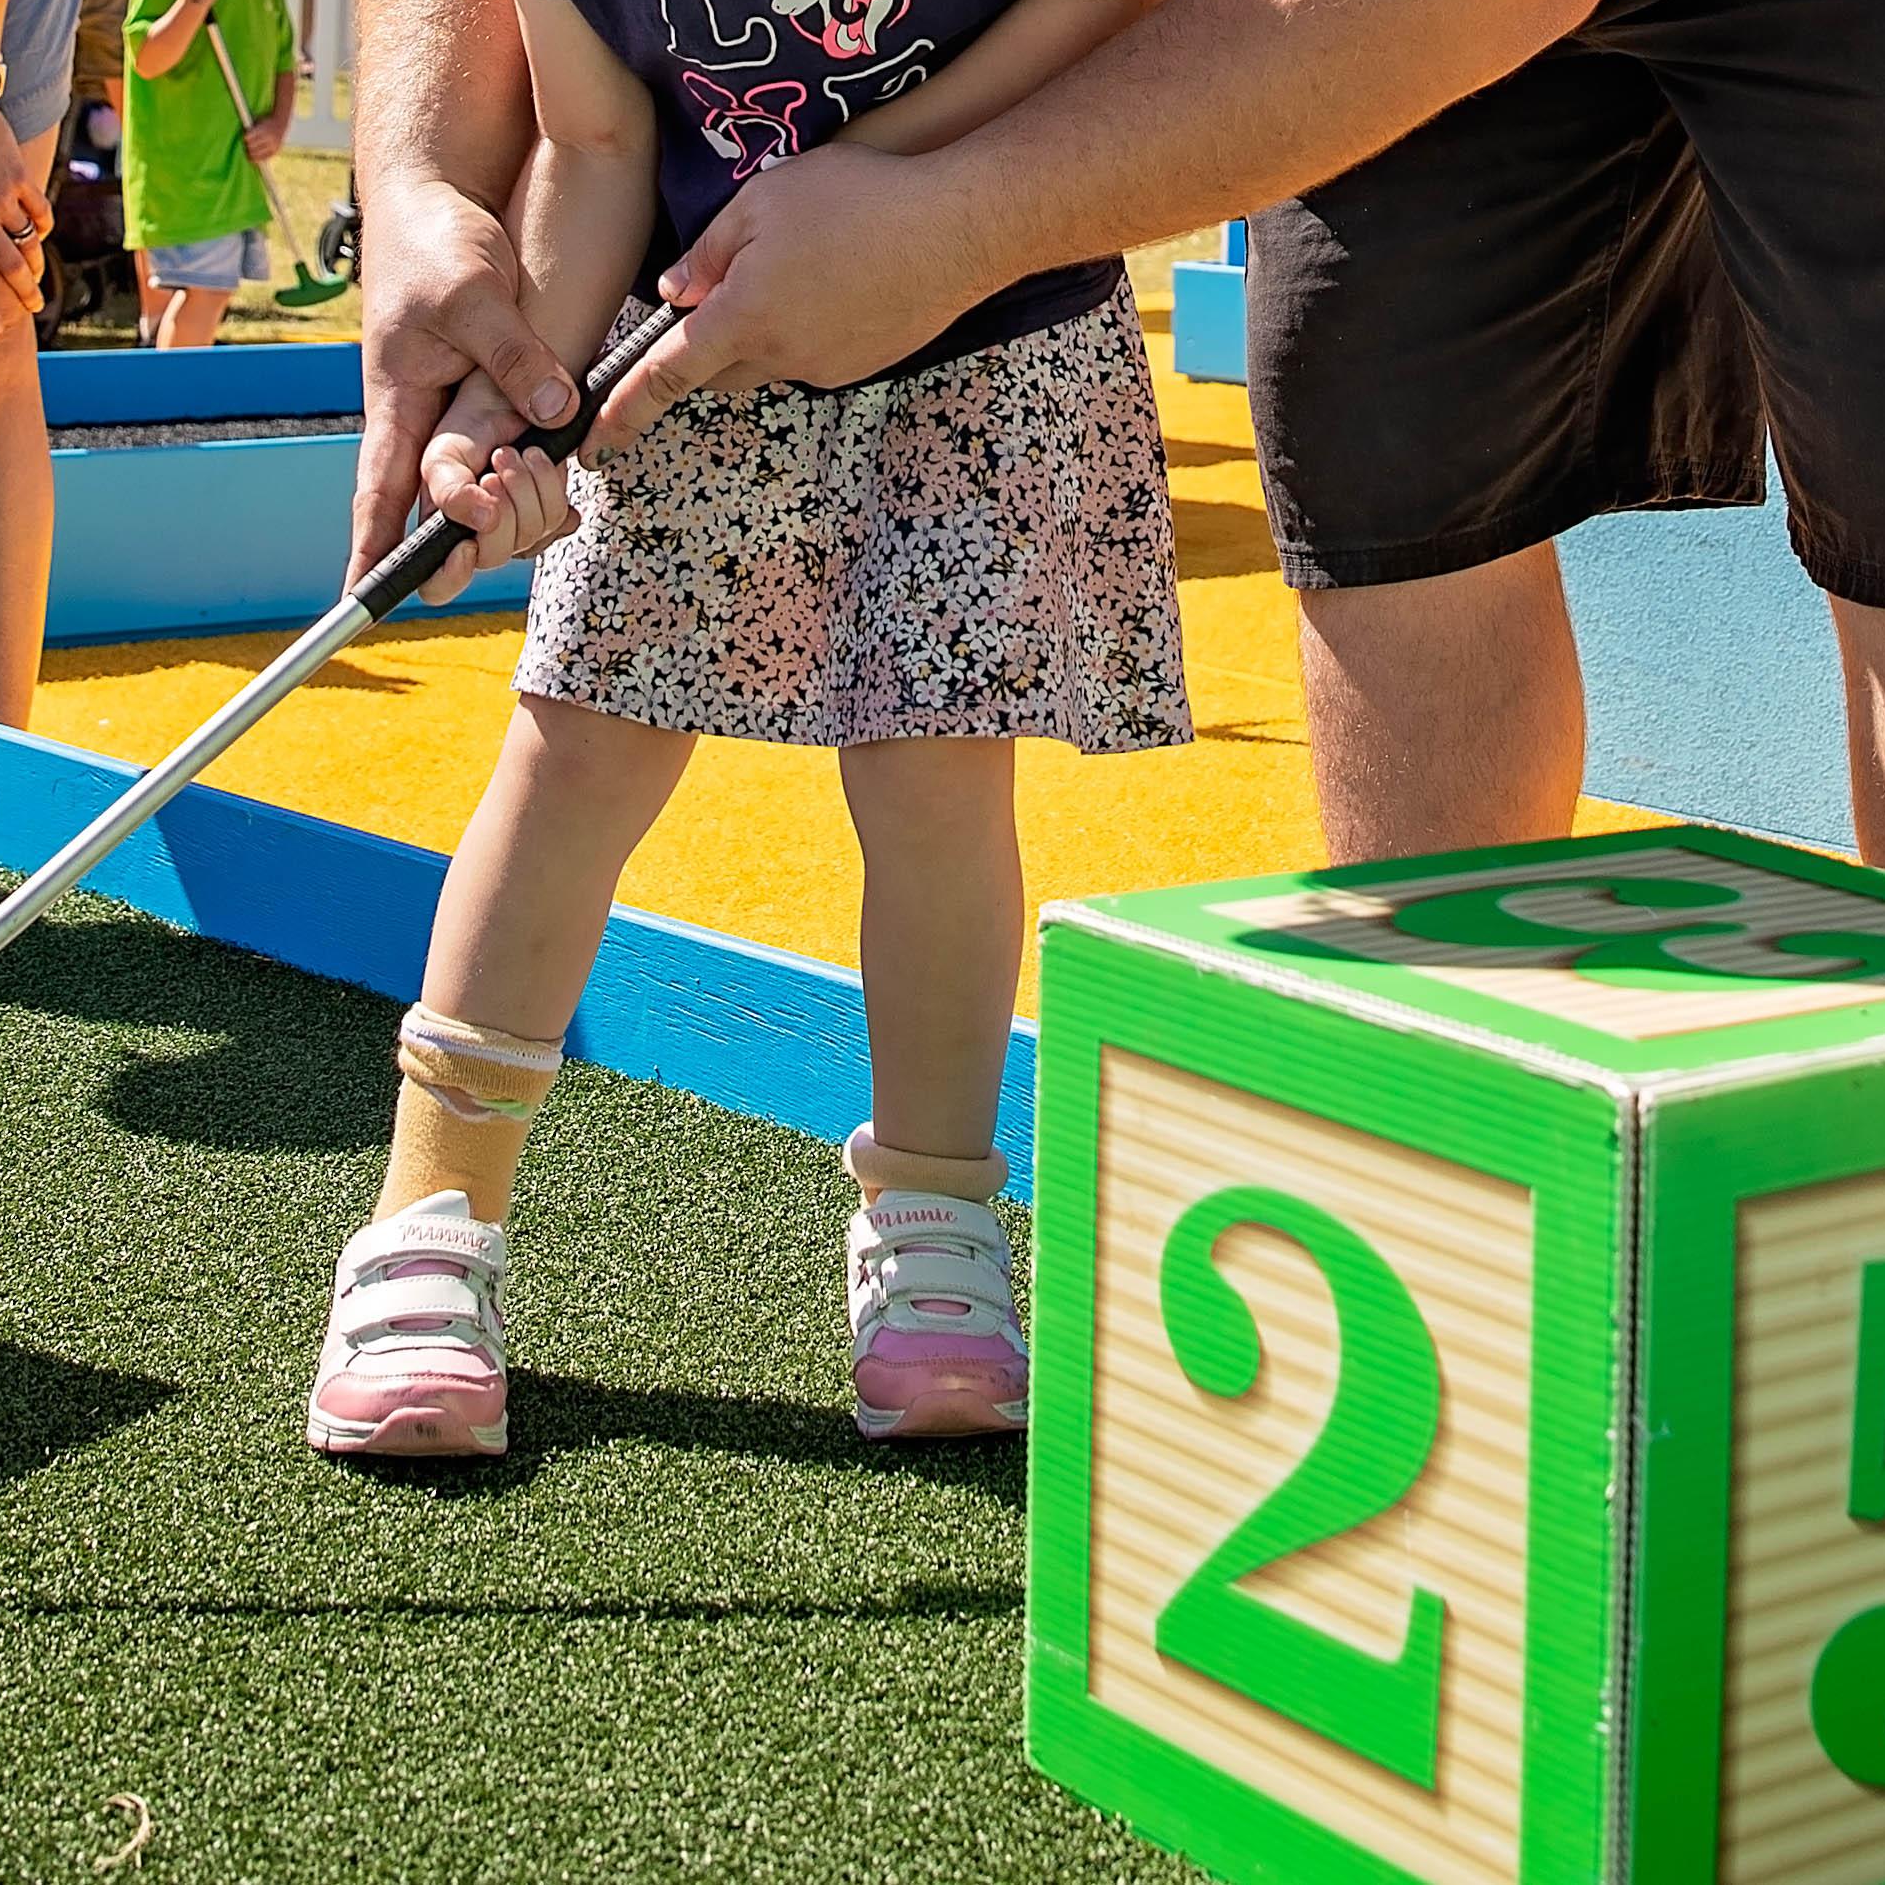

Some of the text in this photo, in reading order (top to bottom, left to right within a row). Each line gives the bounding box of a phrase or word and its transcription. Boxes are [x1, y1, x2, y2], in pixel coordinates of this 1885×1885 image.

[867, 1206, 959, 1232] Minnie
[398, 1223, 491, 1252] Minnie
[1156, 1185, 1445, 1790] 2
